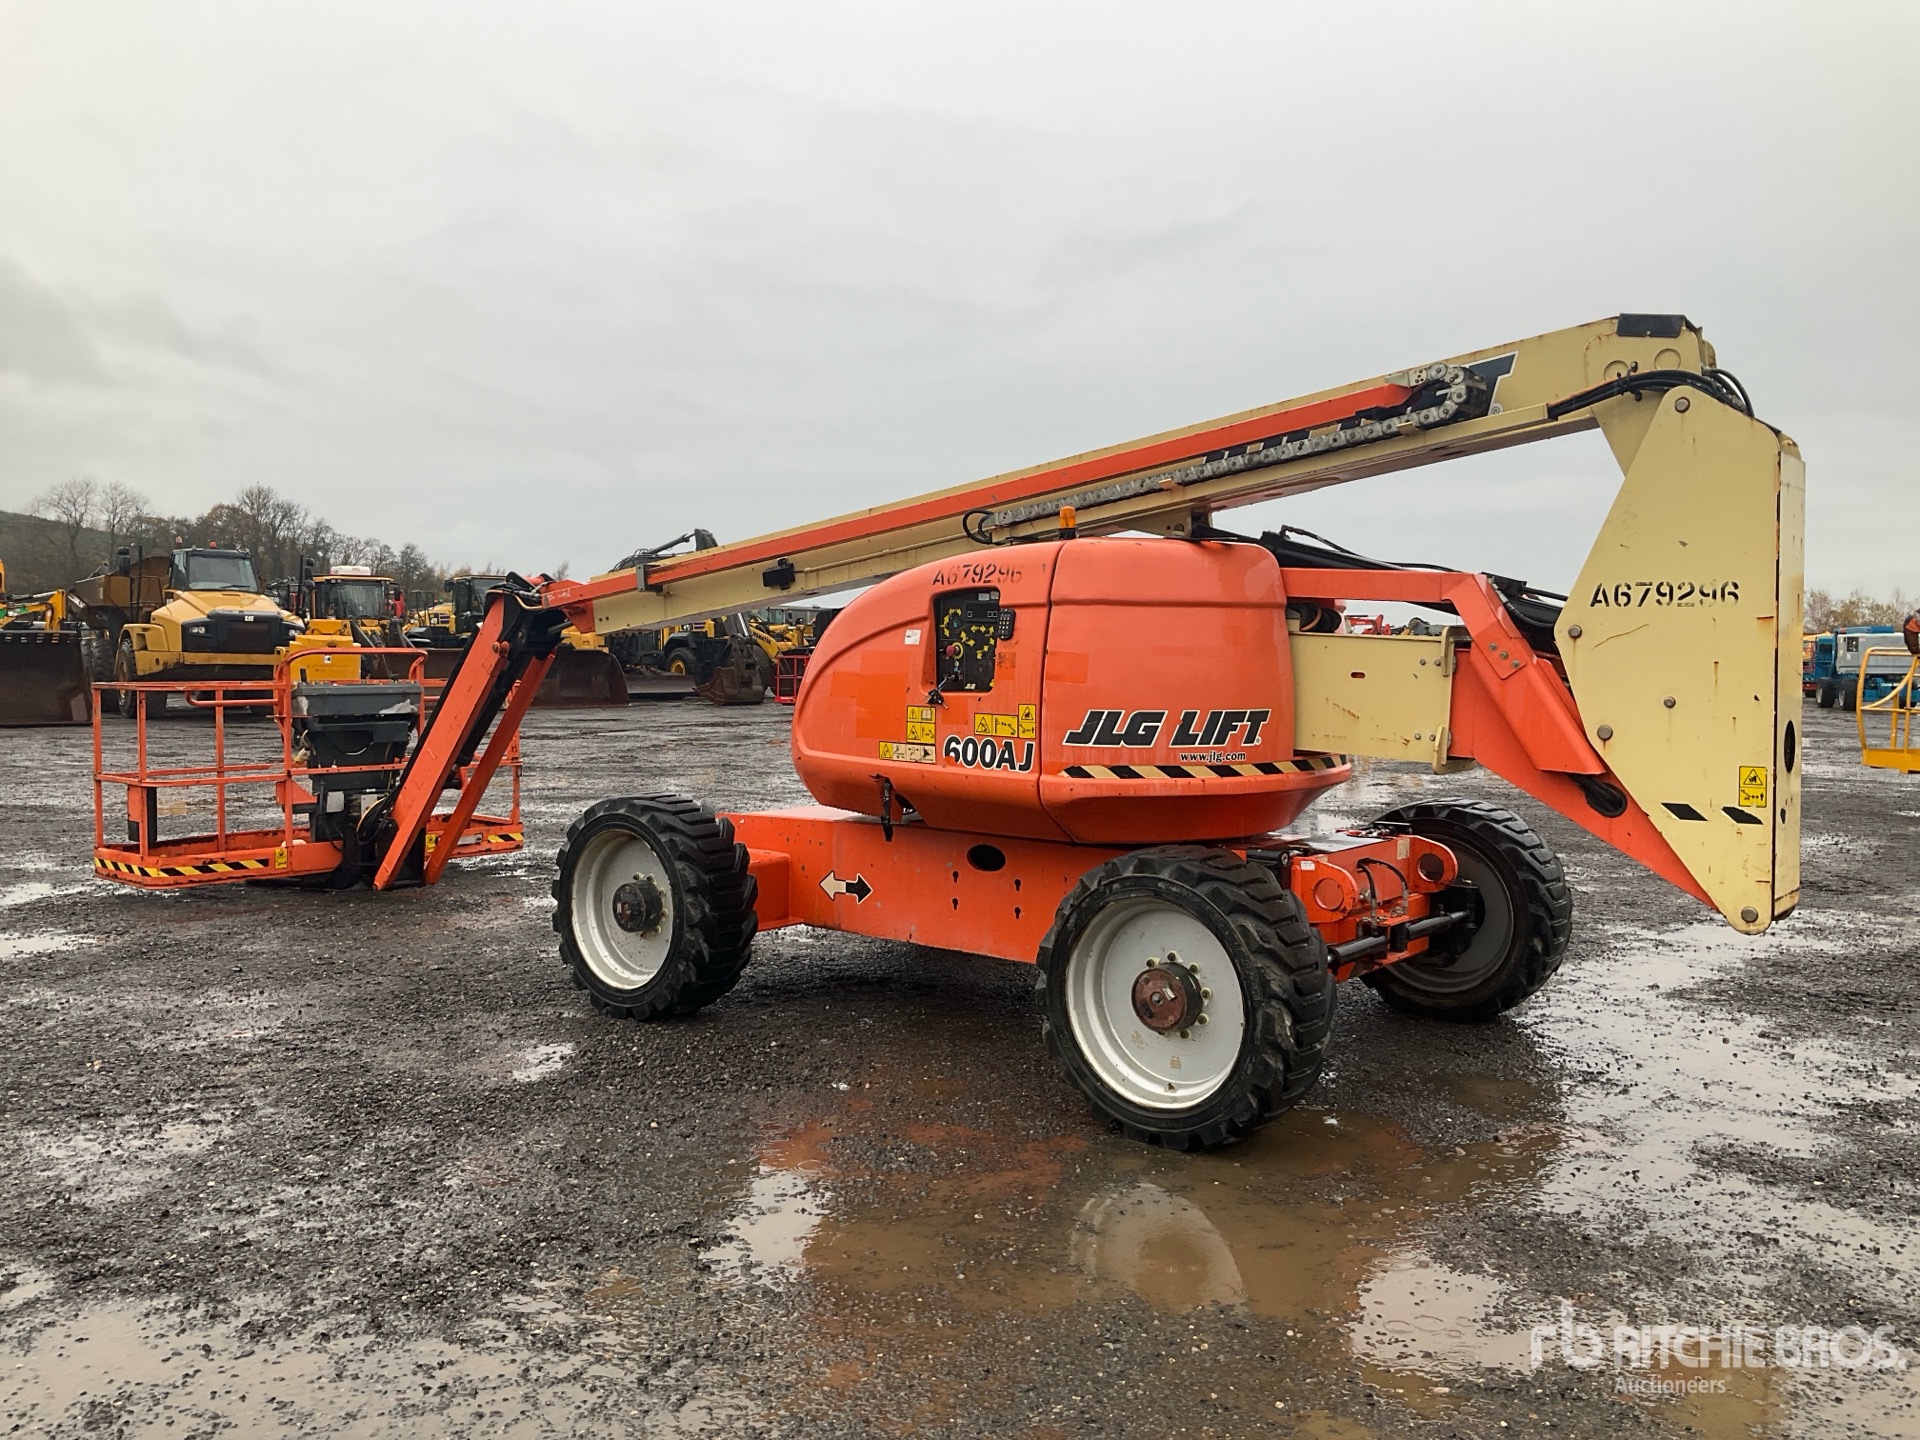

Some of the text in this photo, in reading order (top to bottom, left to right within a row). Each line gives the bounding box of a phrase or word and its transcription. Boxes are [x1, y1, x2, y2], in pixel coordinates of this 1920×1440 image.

[932, 563, 1022, 586] A679296
[1589, 581, 1740, 608] A679296
[1062, 709, 1272, 748] JLG LIFT
[944, 736, 1034, 771] 600AJ
[1180, 752, 1246, 763] www.jlg.com
